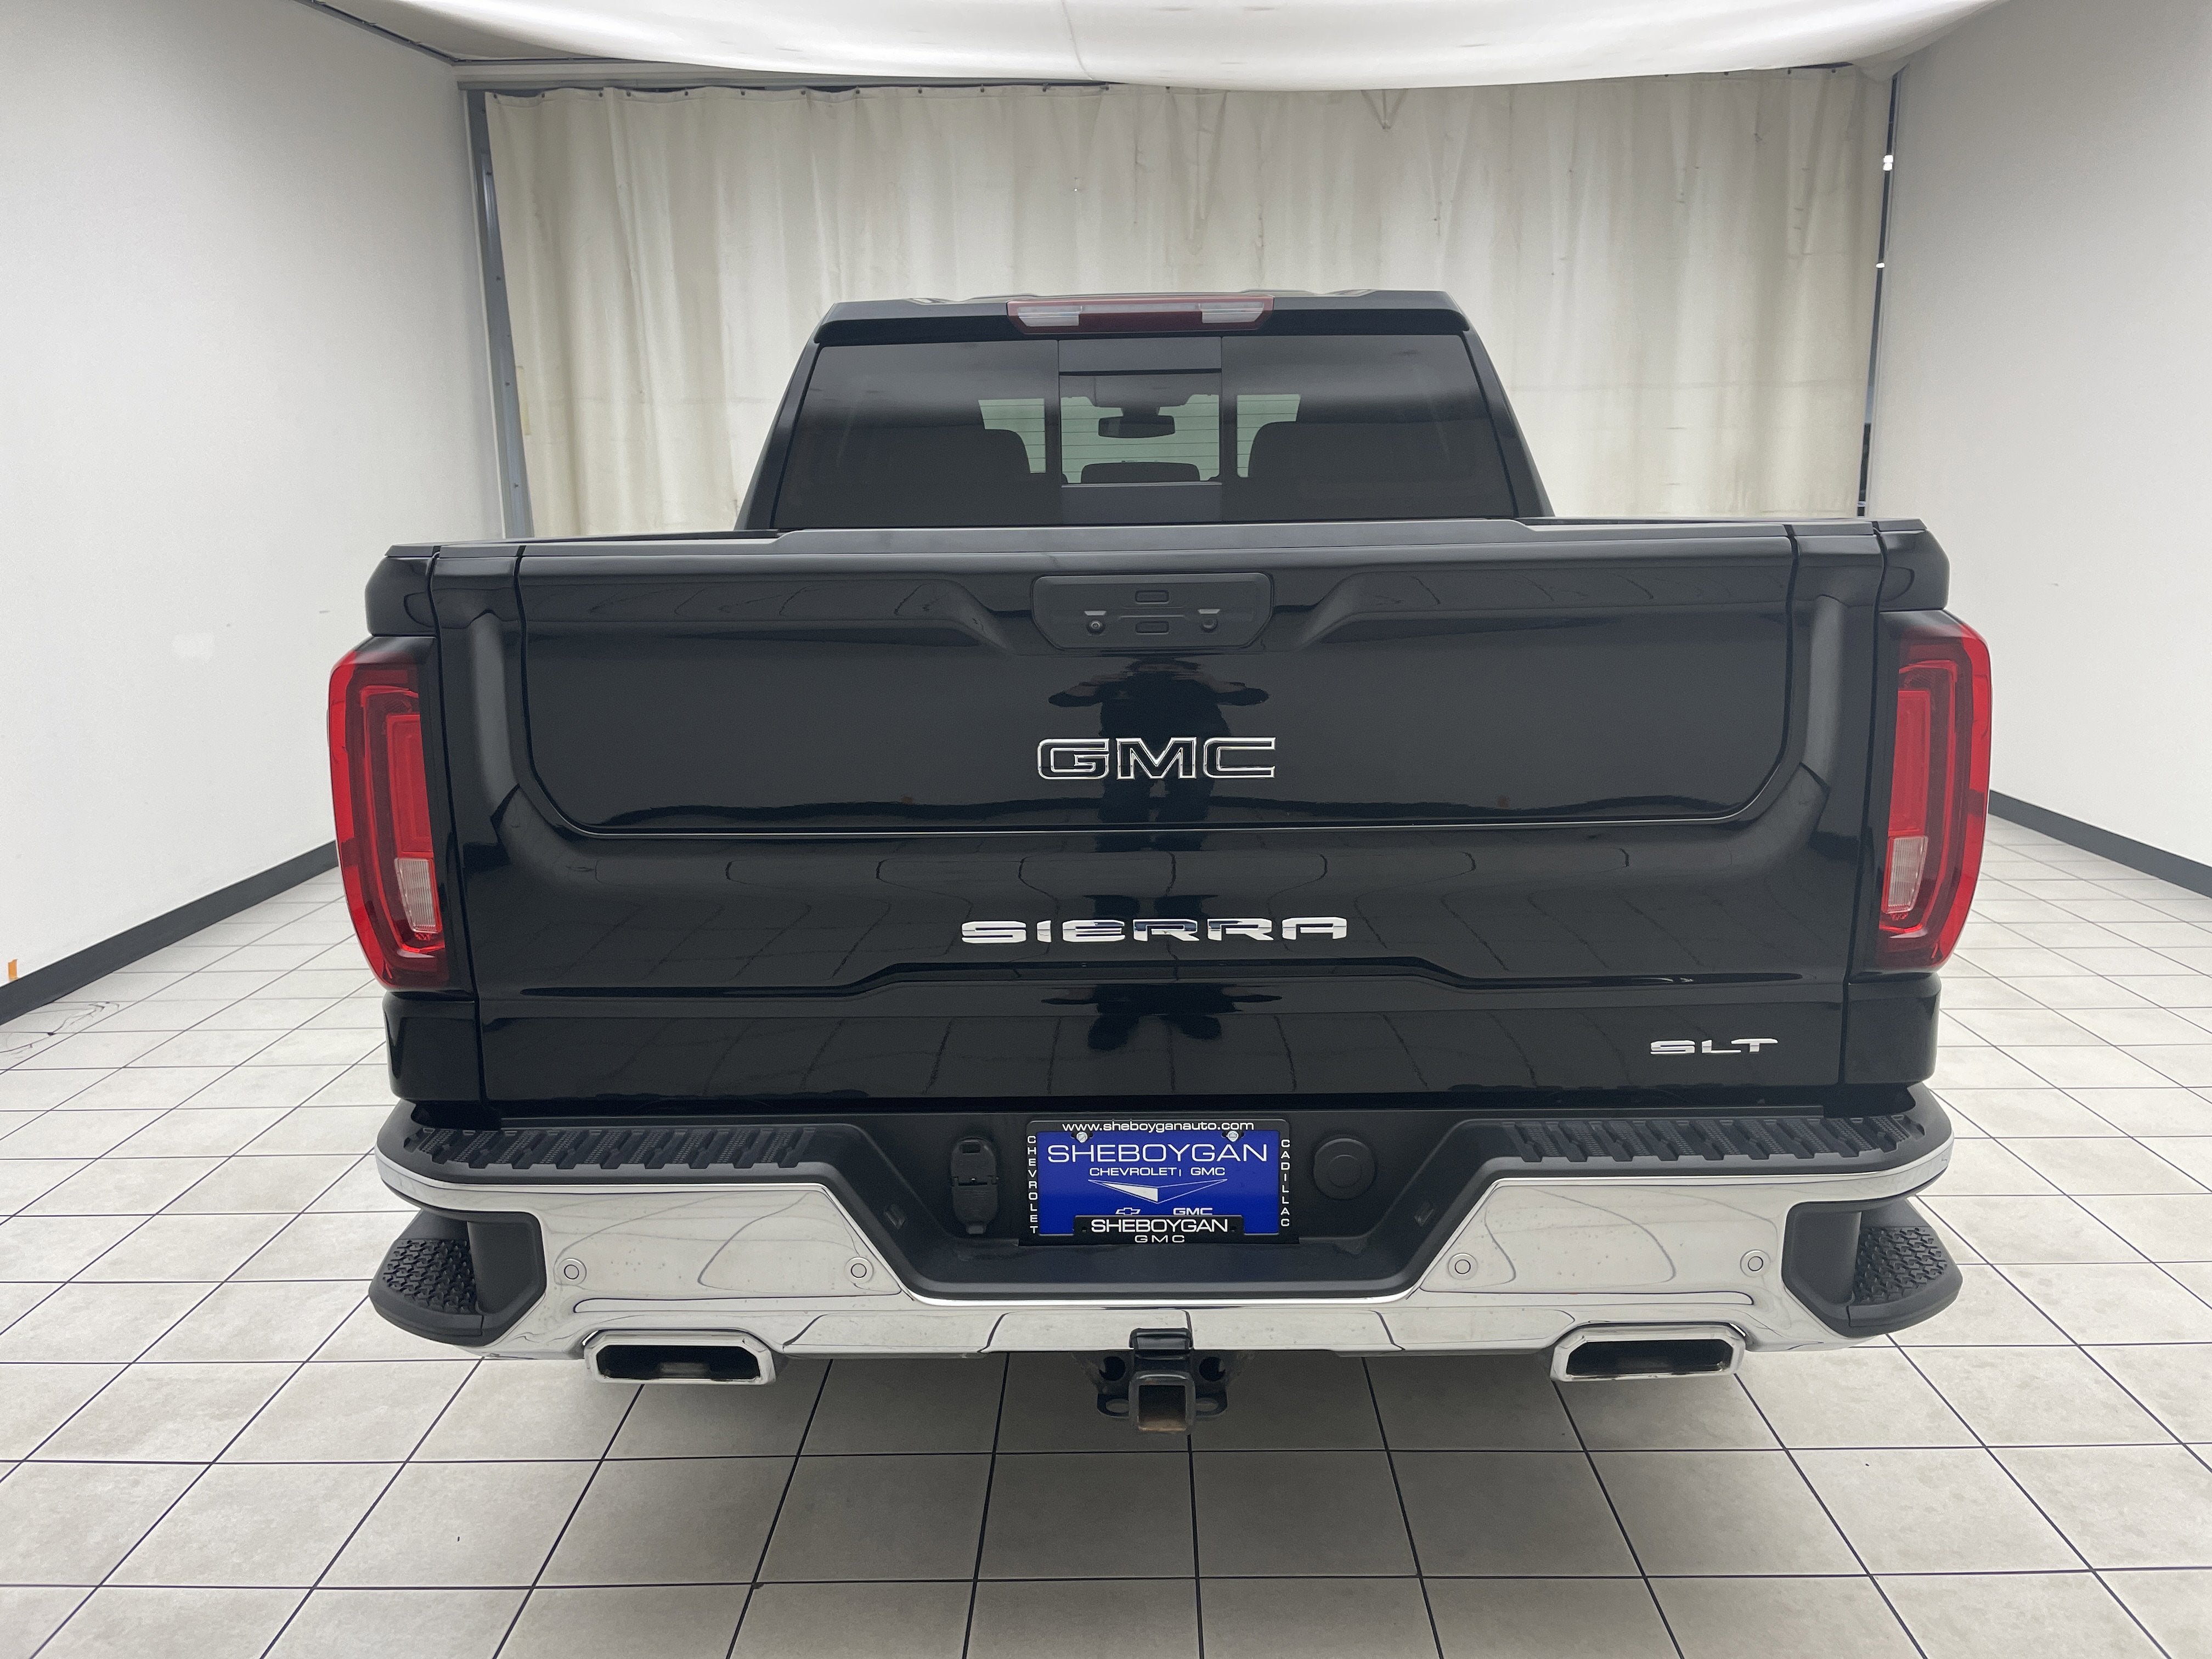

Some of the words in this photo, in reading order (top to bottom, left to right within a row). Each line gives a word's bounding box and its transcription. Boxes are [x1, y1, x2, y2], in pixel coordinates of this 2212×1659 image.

[1037, 737, 1276, 780] GMC
[961, 917, 1347, 943] SIERRA
[1650, 1038, 1778, 1054] SLT
[1062, 1121, 1254, 1132] www.sheboyganauto.com
[1047, 1144, 1267, 1163] SHEBOYGAN
[1089, 1167, 1177, 1176] CHEVROLET
[1190, 1167, 1226, 1176] GMC
[1027, 1135, 1038, 1234] CHEVROLET
[1280, 1139, 1290, 1227] CADILLAC
[1173, 1207, 1213, 1216] GMC
[1091, 1219, 1228, 1232] SHEBOYGAN
[1135, 1235, 1185, 1243] GMC
